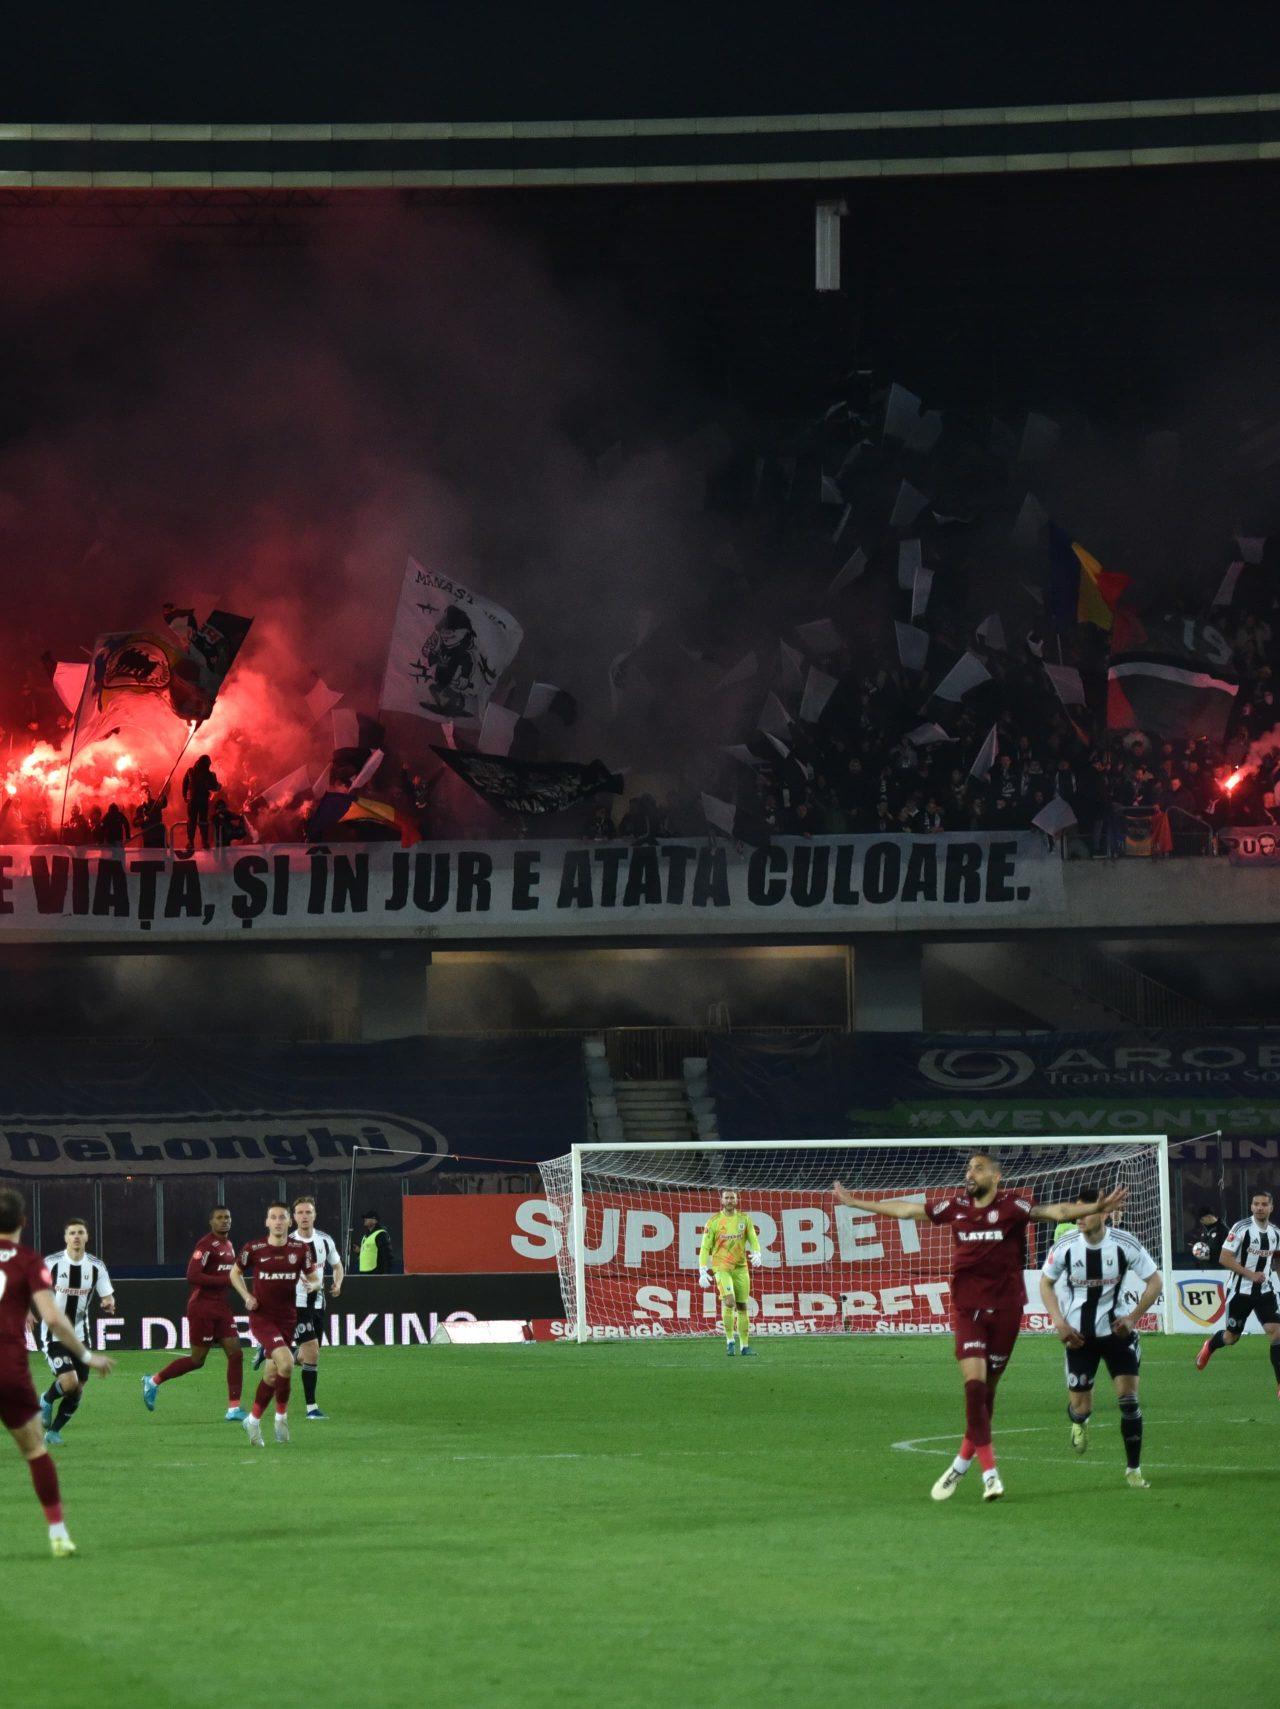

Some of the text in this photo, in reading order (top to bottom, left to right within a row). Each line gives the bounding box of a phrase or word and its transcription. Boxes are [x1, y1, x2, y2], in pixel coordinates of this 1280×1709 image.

[232, 855, 290, 928] ȘI
[306, 846, 369, 914] ÎN
[385, 852, 493, 913] JUR
[512, 851, 540, 910] E
[557, 838, 731, 908] ATÂTA
[748, 841, 1031, 907] CULOARE.
[1043, 1069, 1231, 1086] Transilvania
[1186, 1291, 1216, 1306] BT
